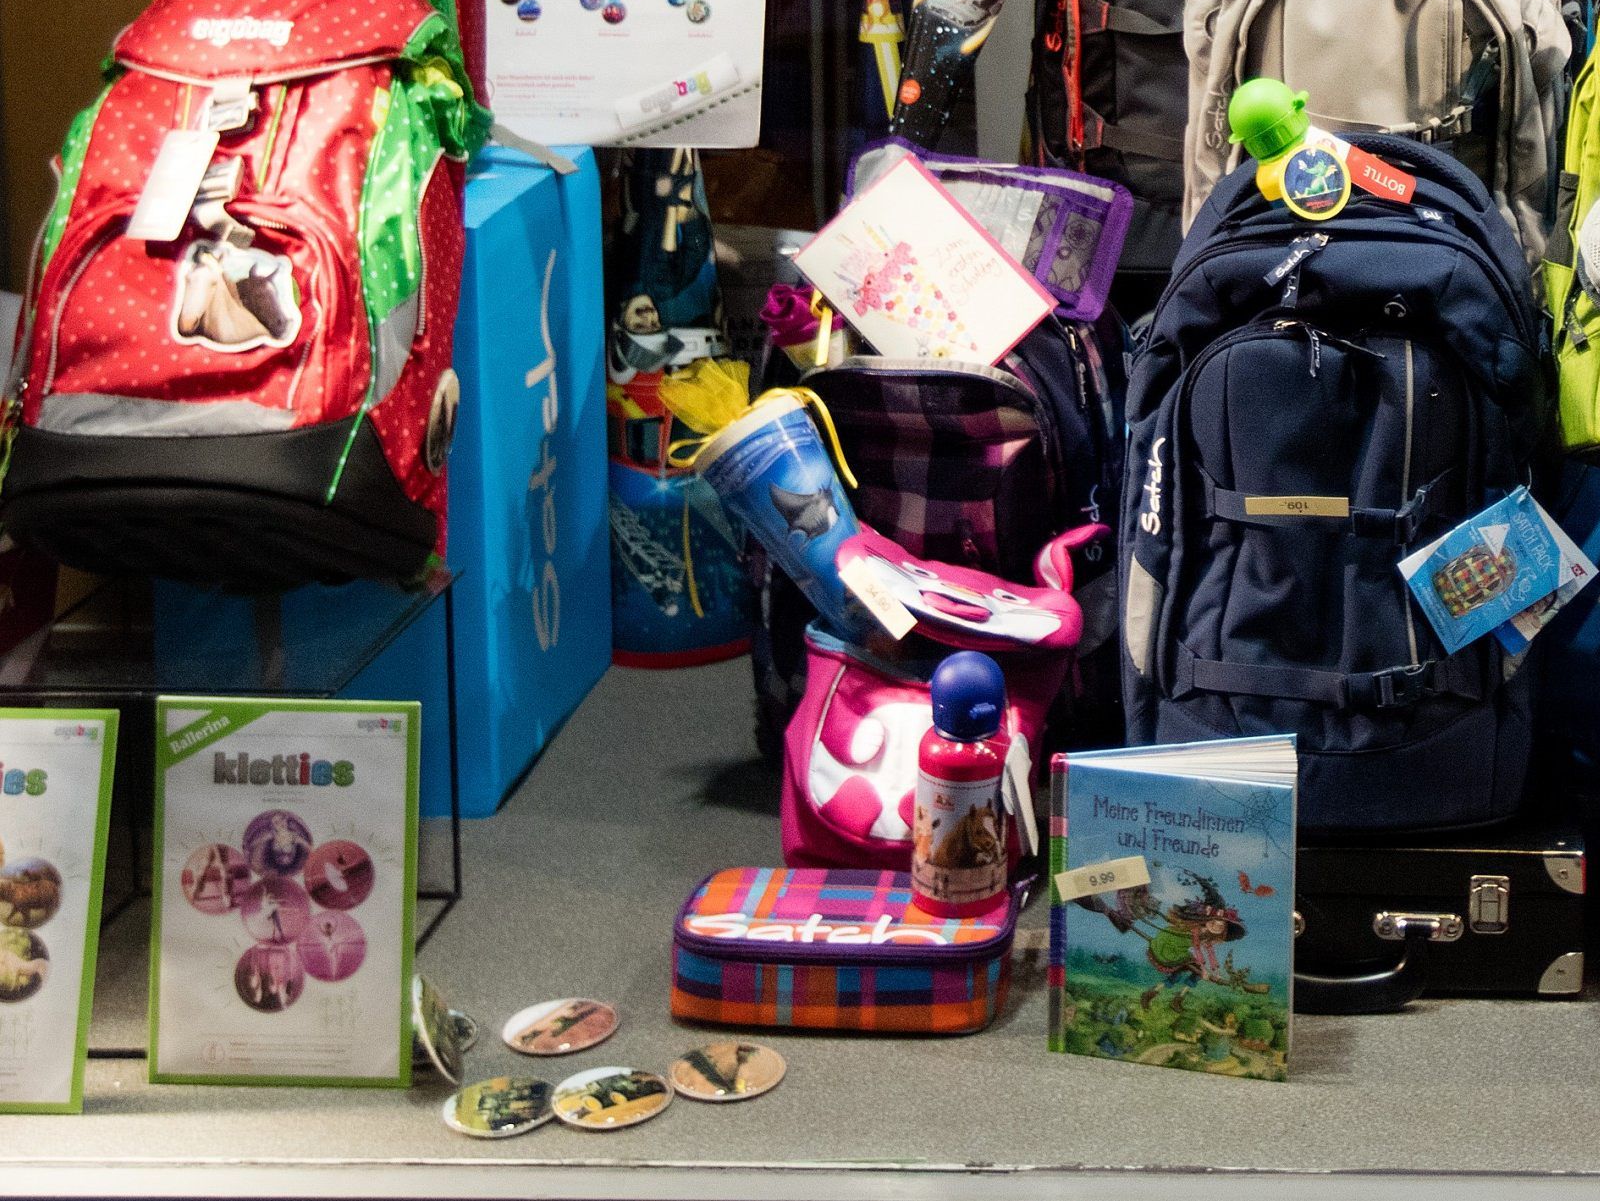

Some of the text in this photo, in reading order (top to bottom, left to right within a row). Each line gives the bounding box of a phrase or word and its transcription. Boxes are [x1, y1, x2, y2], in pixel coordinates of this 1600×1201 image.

[190, 15, 296, 48] ergobag
[1362, 164, 1406, 197] BOTTLE
[525, 248, 560, 653] Satch
[1141, 437, 1167, 536] Satch
[1513, 511, 1556, 574] SATCH PACK
[169, 715, 232, 757] Ballerina
[213, 749, 356, 788] kletties
[1092, 794, 1248, 833] Meine Freundinnen
[1117, 827, 1221, 859] und Freunde
[1089, 871, 1116, 886] 9.99
[689, 913, 949, 946] Satch
